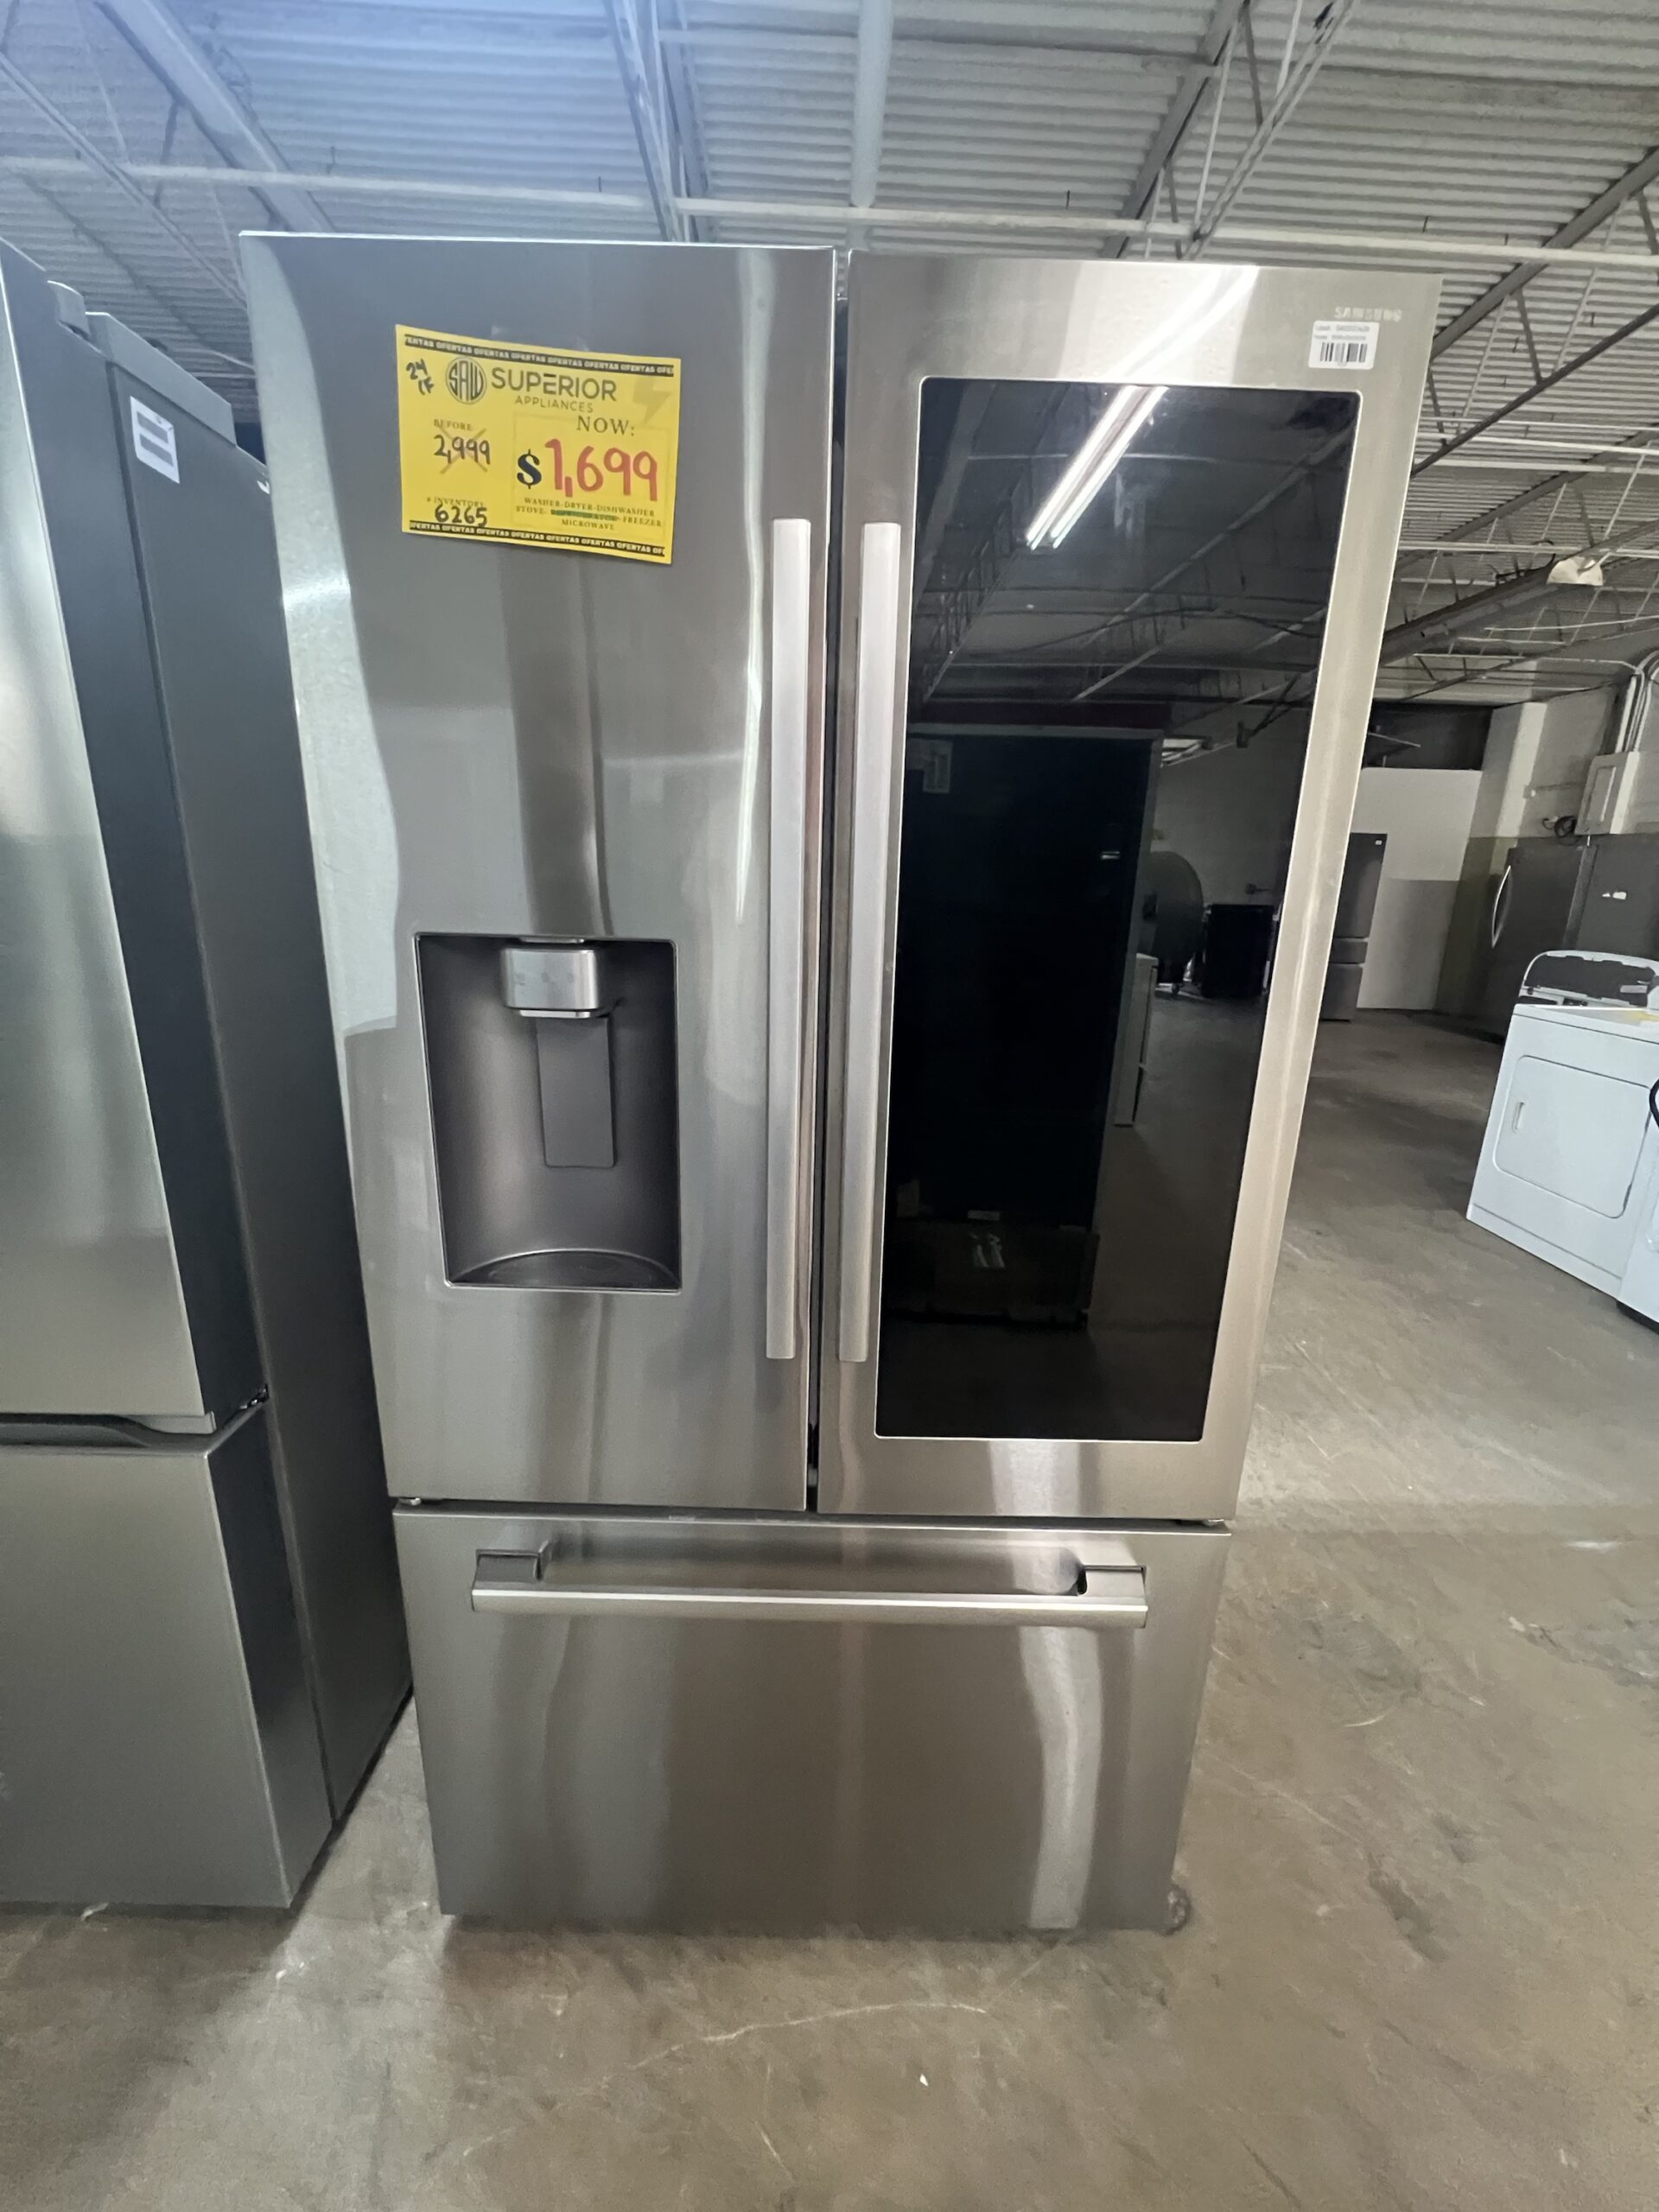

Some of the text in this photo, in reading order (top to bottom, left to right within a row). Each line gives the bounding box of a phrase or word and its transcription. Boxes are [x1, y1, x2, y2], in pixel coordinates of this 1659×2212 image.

[435, 342, 473, 354] OFERTAS
[474, 347, 510, 359] OFERTAS
[511, 352, 546, 363] OFERTAS
[547, 356, 583, 367] OFERTAS
[584, 360, 620, 371] OFERTAS
[620, 364, 655, 373] OFERTAS
[406, 358, 429, 380] 24
[491, 366, 617, 402] SUPERIOR
[515, 395, 594, 414] APPLIANCES
[434, 418, 474, 432] BEFORE
[576, 415, 635, 436] NOW:
[435, 500, 488, 528] 6265
[562, 518, 615, 531] MICROWAVE
[442, 524, 475, 534] OFERTAS
[476, 528, 510, 537] OFERTAS
[511, 531, 544, 540] OFERTAS
[546, 534, 580, 543] OFERTAS
[581, 538, 615, 548] OFERTAS
[616, 543, 651, 553] OFERTAS
